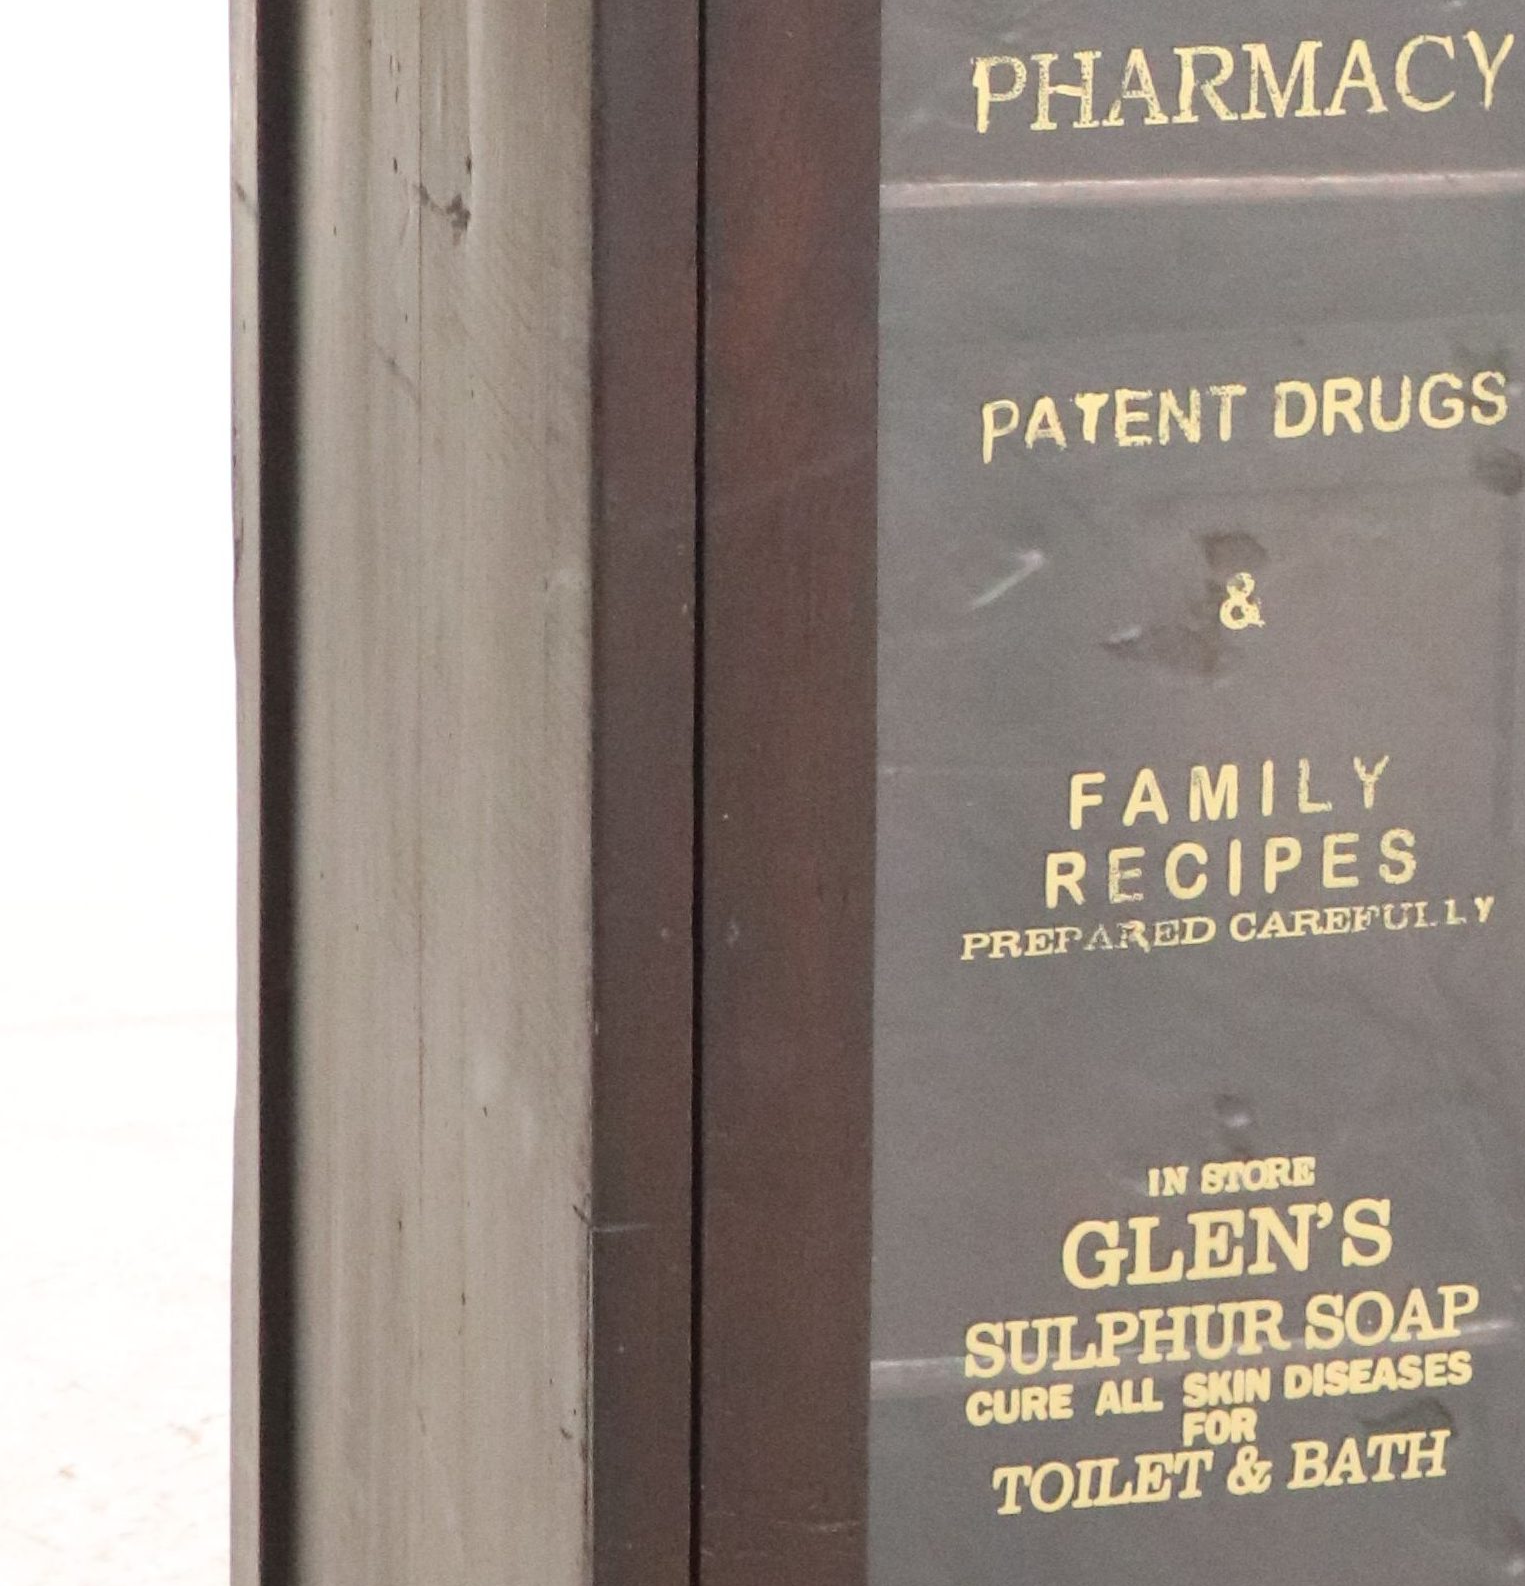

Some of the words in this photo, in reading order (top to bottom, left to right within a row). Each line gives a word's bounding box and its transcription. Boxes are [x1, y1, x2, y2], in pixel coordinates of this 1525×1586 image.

[970, 27, 1516, 135] PHARMACY
[979, 382, 1248, 464] PATENT
[1272, 369, 1510, 439] DRUGS
[1218, 569, 1266, 632] &
[1068, 754, 1390, 831] FAMILY
[1044, 824, 1419, 909] RECIPES
[960, 916, 1217, 962] PREPARED
[1146, 1162, 1189, 1198] IN
[1199, 1155, 1317, 1197] STORE
[1060, 1196, 1394, 1291] GLEN'S
[962, 1296, 1292, 1380] SULPHUR
[1301, 1282, 1481, 1353] SOAP
[964, 1380, 1075, 1427] CURE
[1093, 1374, 1164, 1417] ALL
[1181, 1363, 1273, 1411] SKIN
[1281, 1349, 1474, 1401] DISEASES
[1181, 1405, 1259, 1449] FOR
[990, 1447, 1215, 1517] TOILET
[1225, 1442, 1274, 1496] &
[1286, 1427, 1453, 1490] BATH
